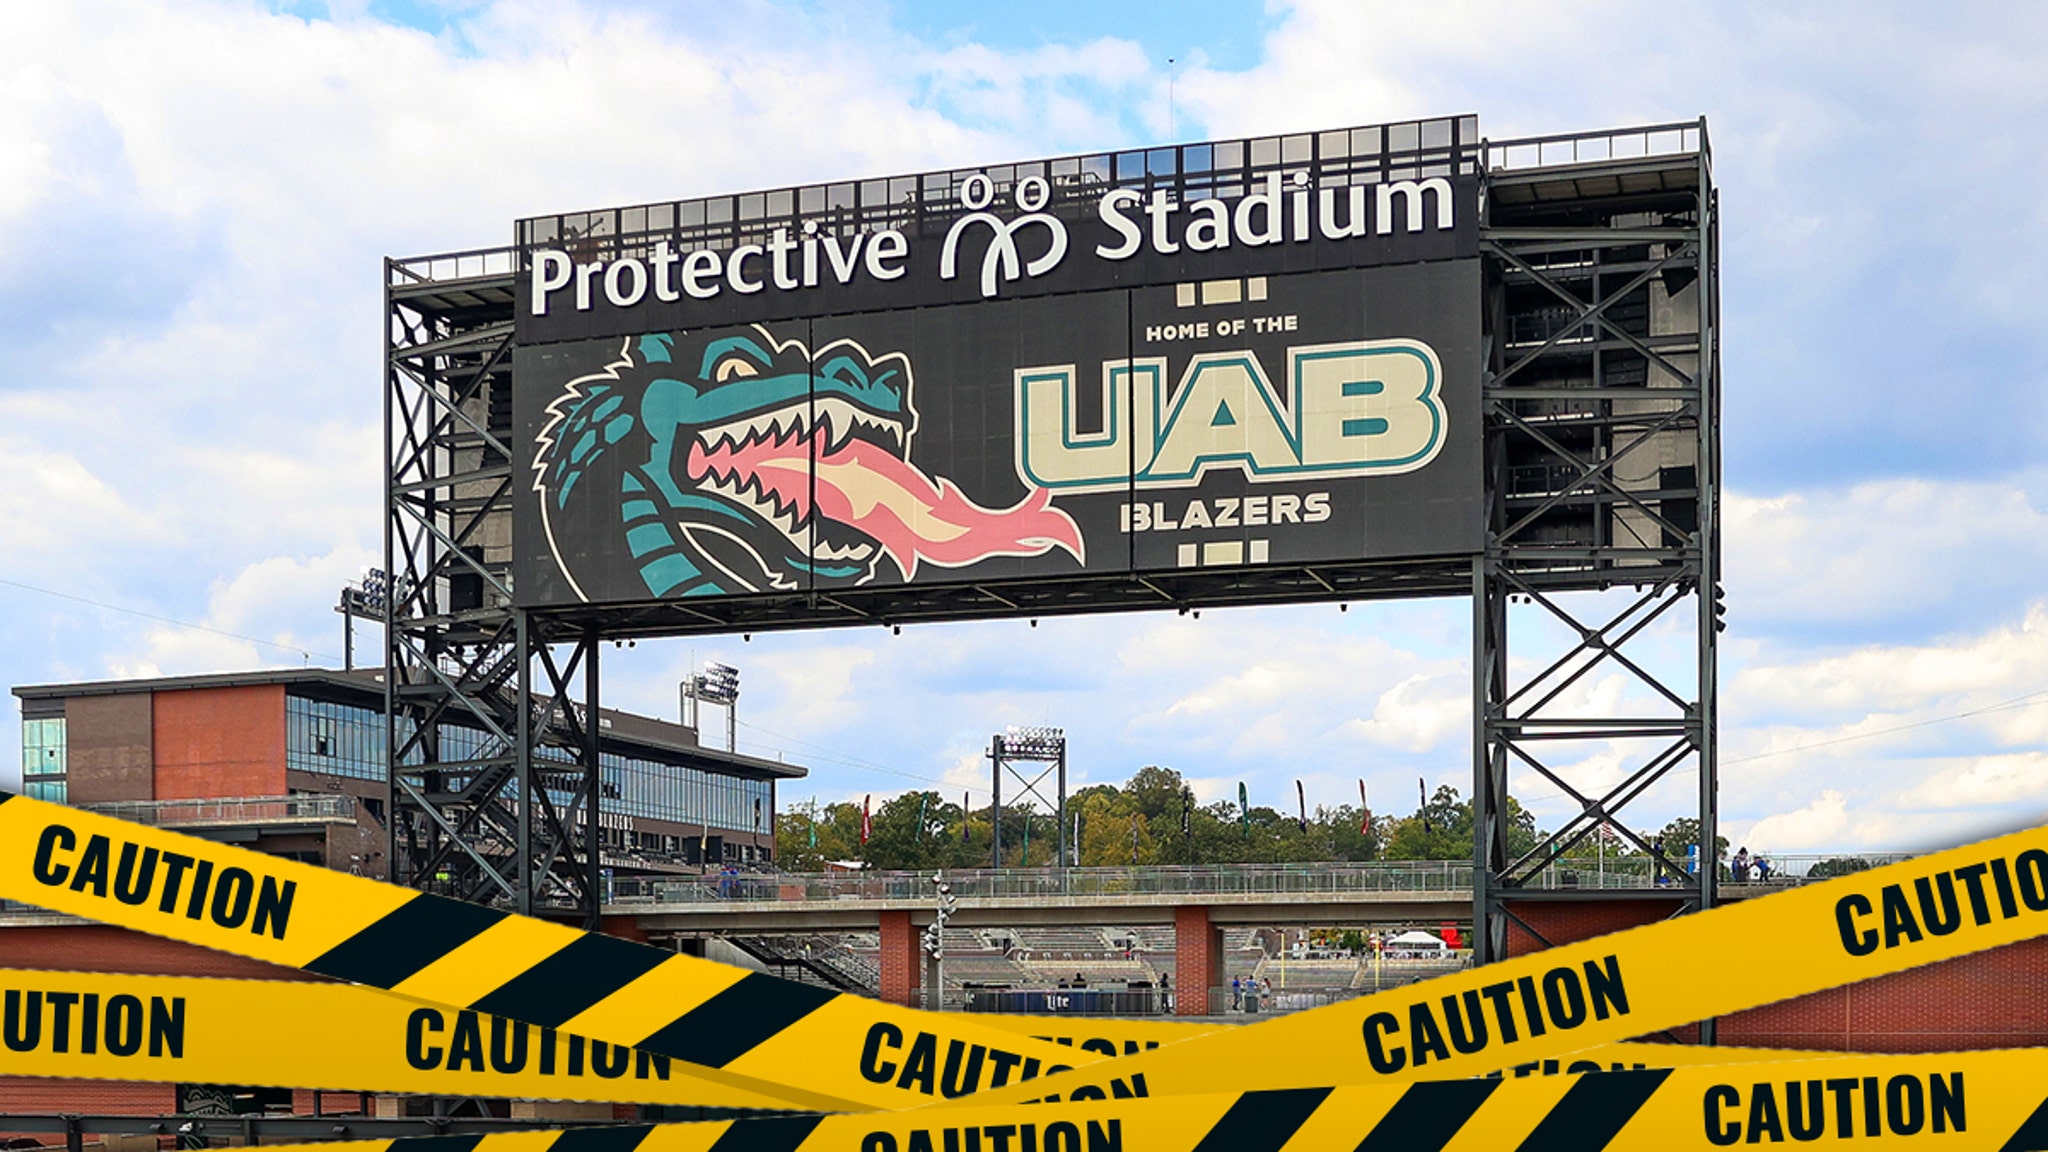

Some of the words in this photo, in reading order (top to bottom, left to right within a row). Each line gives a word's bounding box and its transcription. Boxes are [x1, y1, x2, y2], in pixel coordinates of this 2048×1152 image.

[531, 219, 909, 316] Protective
[1095, 170, 1455, 260] Stadium
[1146, 321, 1209, 342] HOME
[1216, 319, 1246, 337] OF
[1252, 314, 1299, 334] THE
[1013, 337, 1449, 497] UAB
[1120, 492, 1332, 533] BLAZERS
